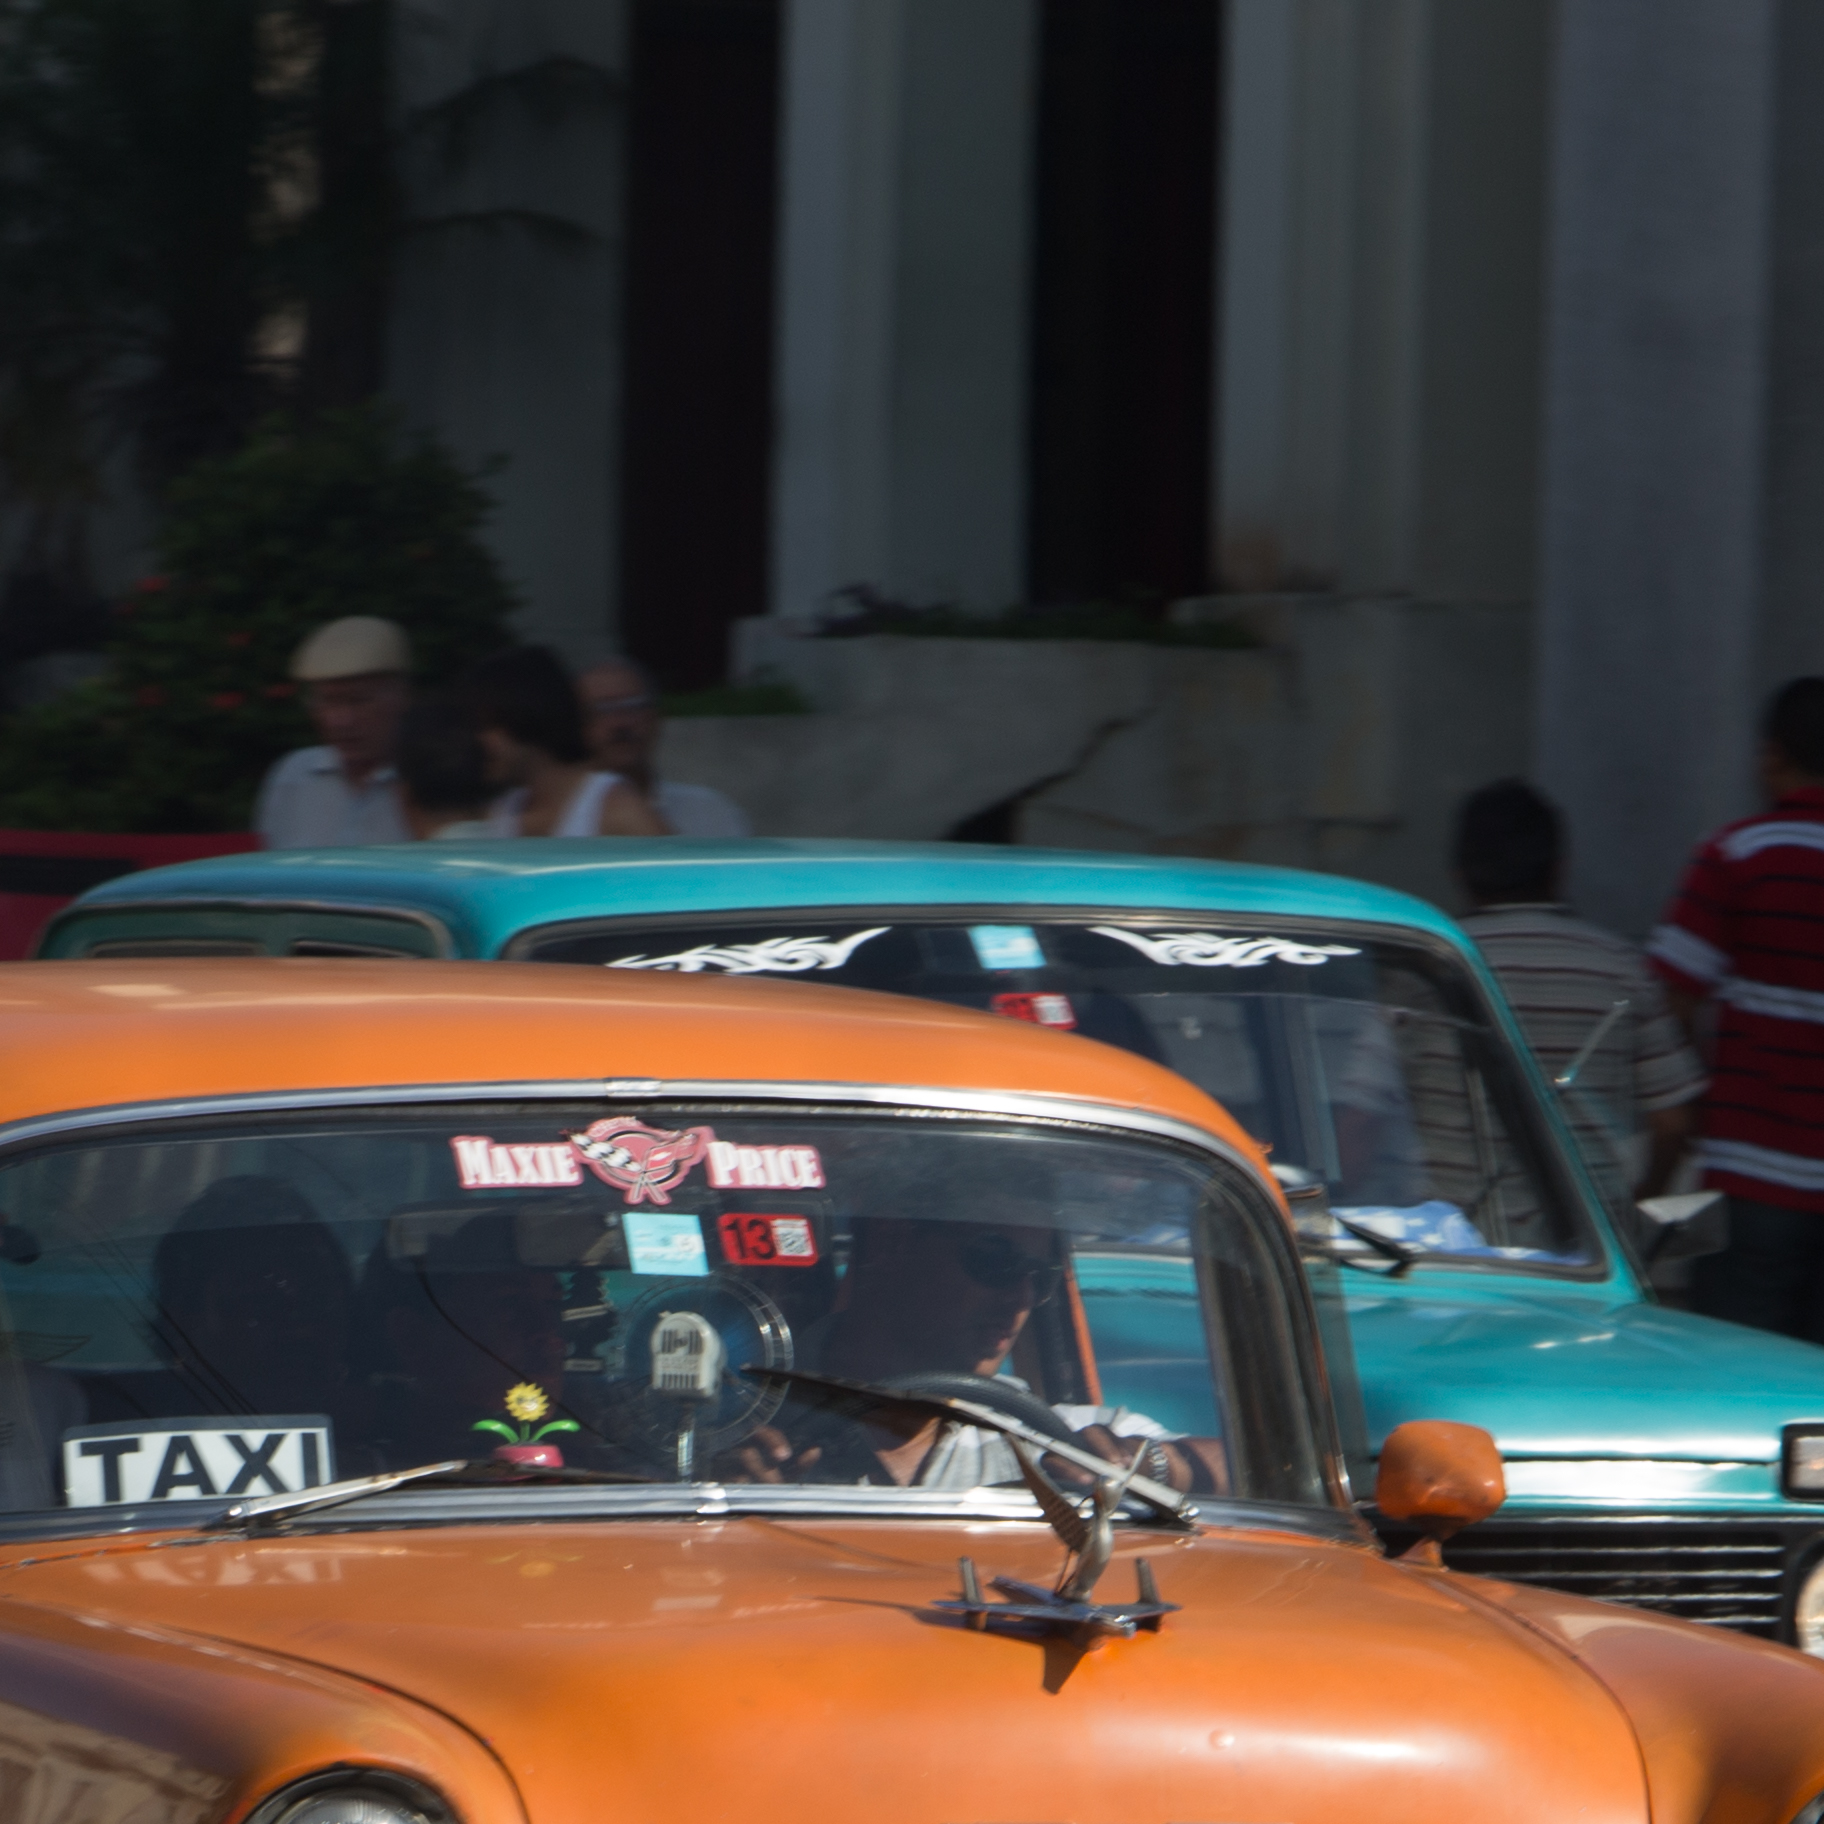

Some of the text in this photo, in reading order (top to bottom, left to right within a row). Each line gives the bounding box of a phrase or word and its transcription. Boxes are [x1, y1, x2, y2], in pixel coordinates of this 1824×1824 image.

[455, 1139, 822, 1188] MAXIE PRICE
[723, 1217, 777, 1261] 13
[79, 1432, 320, 1503] TAXI
